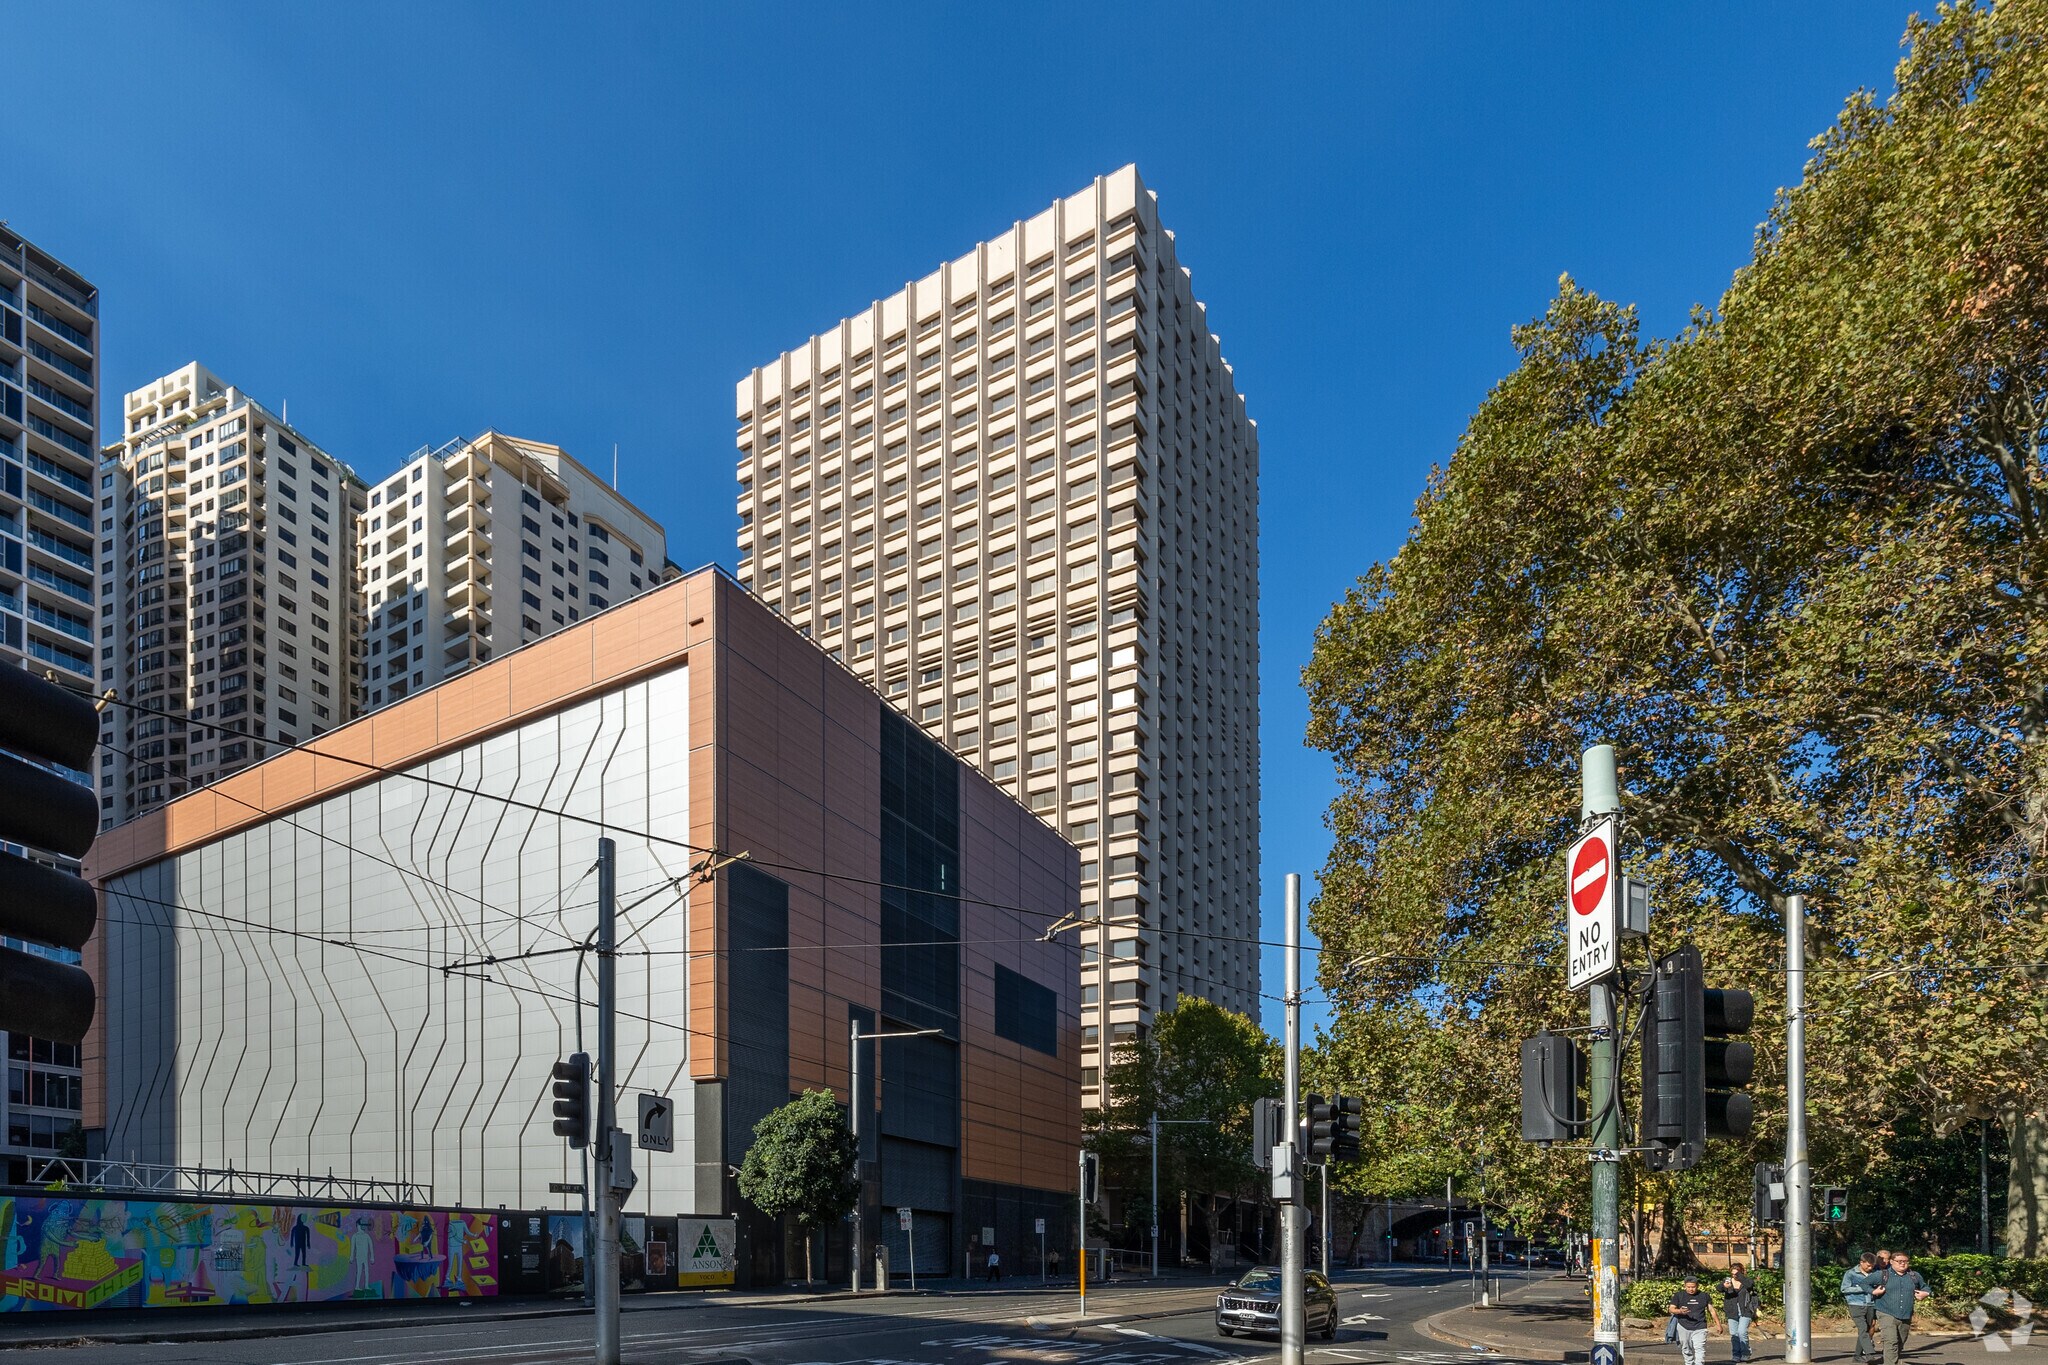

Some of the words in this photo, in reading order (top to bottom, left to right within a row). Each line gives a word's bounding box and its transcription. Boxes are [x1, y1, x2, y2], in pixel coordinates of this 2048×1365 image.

[1579, 921, 1601, 951] NO
[1572, 941, 1610, 977] ENTRY
[641, 1133, 670, 1146] ONLY
[691, 1259, 723, 1270] ANSON
[89, 1264, 140, 1302] THIS
